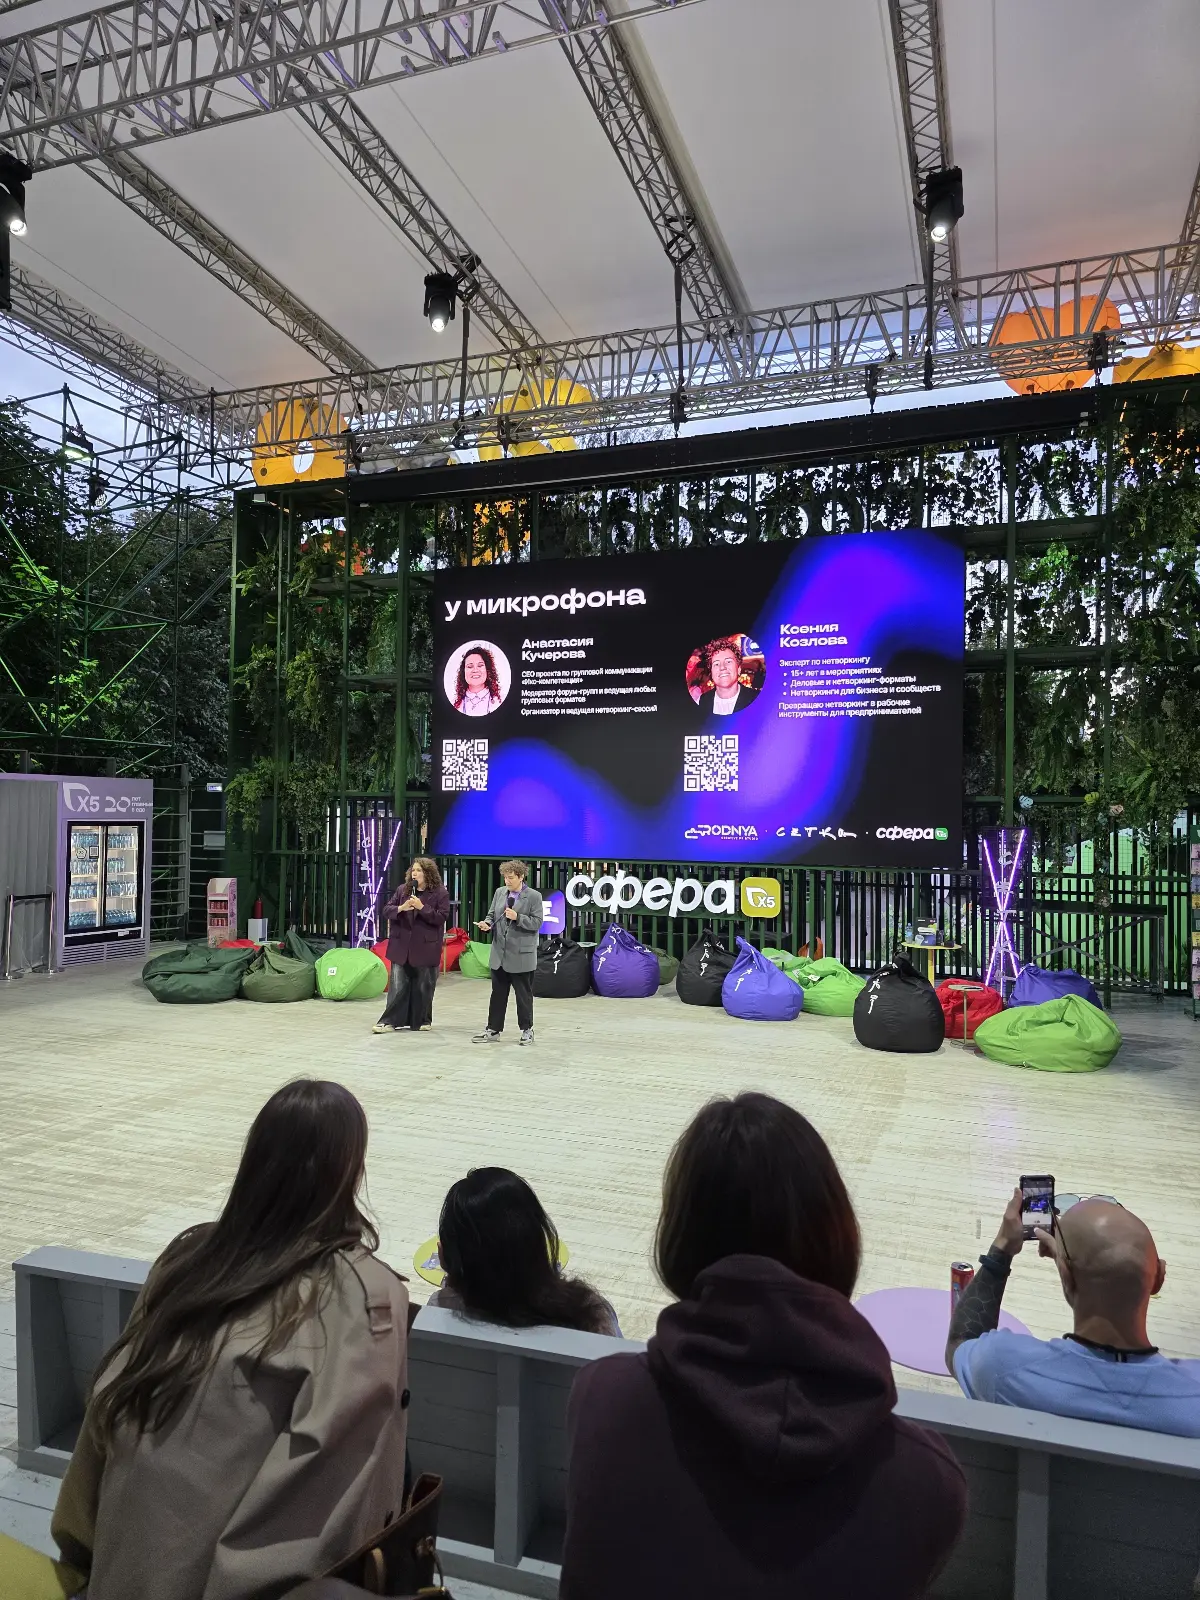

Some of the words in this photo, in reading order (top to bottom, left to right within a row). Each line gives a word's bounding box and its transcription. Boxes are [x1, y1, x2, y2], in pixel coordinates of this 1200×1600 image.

[445, 601, 461, 622] у
[467, 588, 647, 617] микрофона
[780, 623, 839, 635] Ксения
[522, 637, 594, 650] Анастасия
[780, 636, 848, 648] Козлова
[522, 650, 587, 662] Кучерова
[822, 657, 870, 665] нетворкингу
[571, 668, 604, 677] групповой
[605, 667, 653, 675] коммуникации
[826, 668, 882, 677] мероприятиях
[791, 679, 824, 688] Деловые
[832, 676, 916, 686] нетворкинг-форматы
[522, 690, 555, 698] Модератор
[557, 688, 598, 696] форум-групп
[604, 687, 633, 695] ведущая
[791, 689, 839, 698] Нетворкинги
[840, 688, 855, 696] для
[896, 685, 941, 694] сообществ
[521, 698, 554, 706] групповых
[555, 696, 586, 705] форматов
[779, 703, 824, 711] Превращаю
[825, 701, 868, 710] нетворкинг
[877, 699, 911, 708] рабочие
[521, 708, 560, 717] Организатор
[596, 705, 658, 715] нетворкинг-сессий
[779, 710, 828, 719] инструменты
[846, 707, 922, 717] предпринимателей
[77, 796, 100, 812] X5
[105, 796, 130, 812] 20
[697, 825, 758, 836] RODNYA
[876, 826, 934, 841] сфера
[565, 870, 735, 918] сфера
[757, 896, 775, 909] X5
